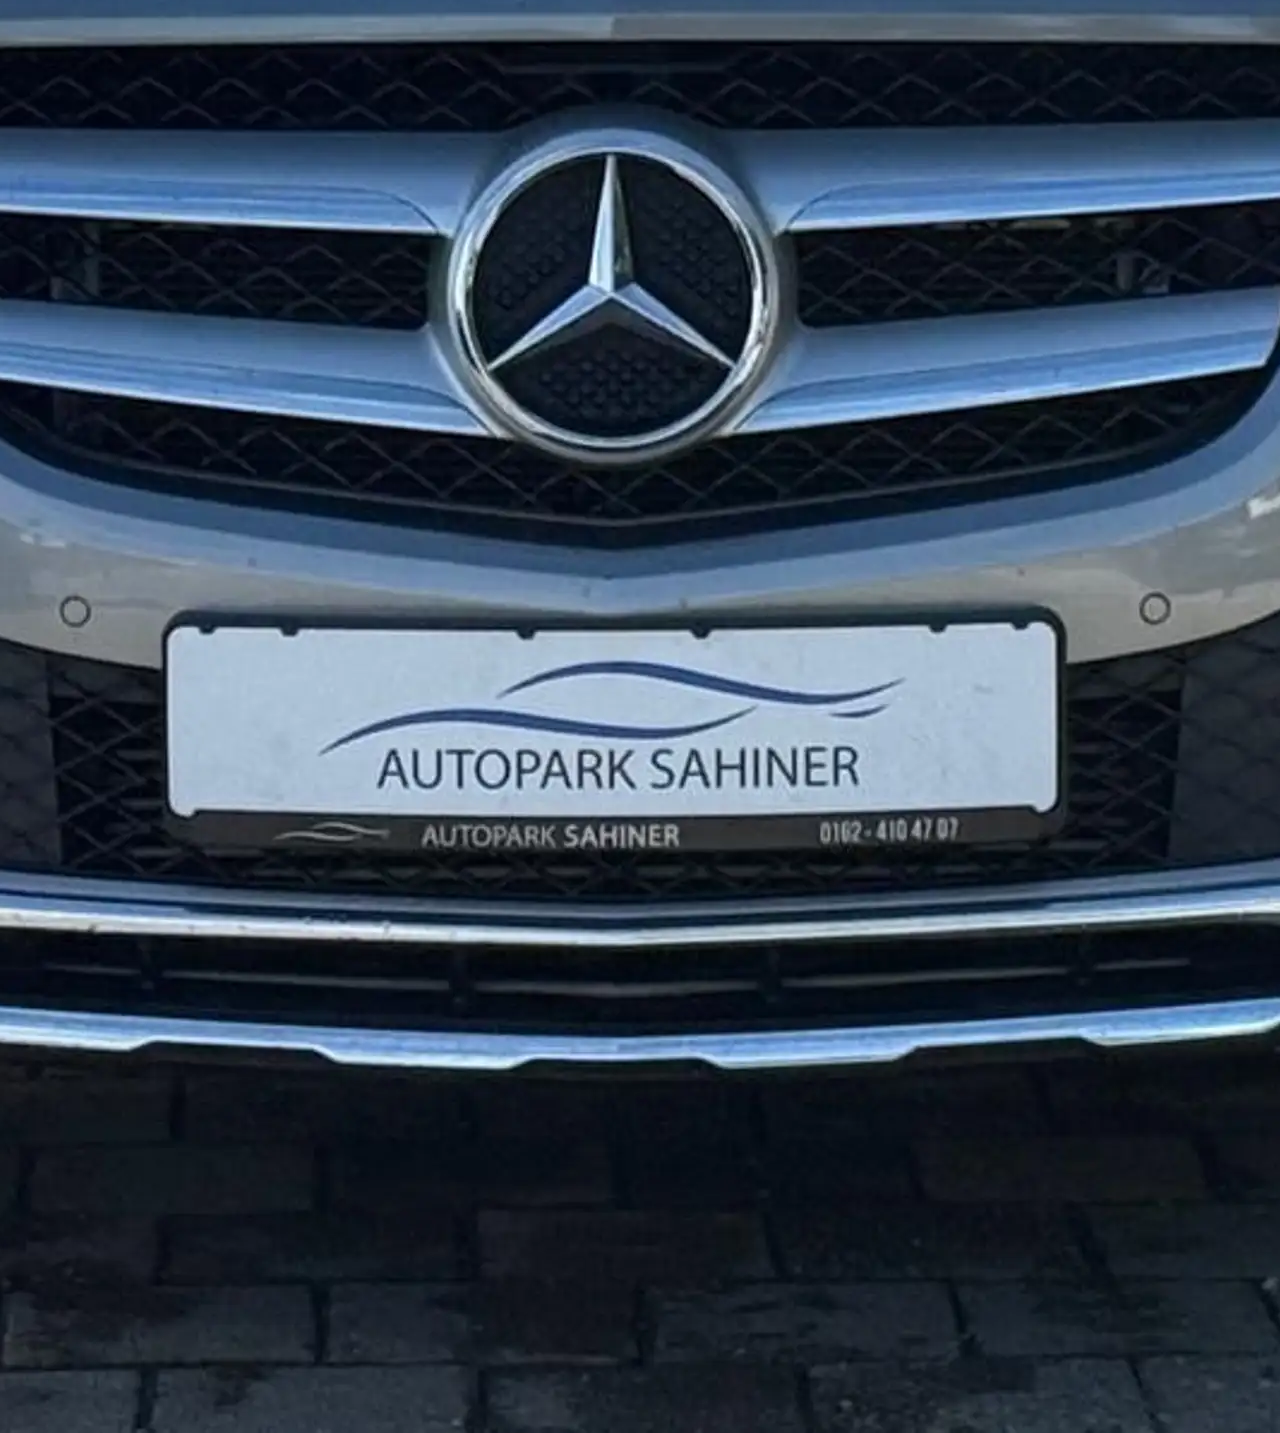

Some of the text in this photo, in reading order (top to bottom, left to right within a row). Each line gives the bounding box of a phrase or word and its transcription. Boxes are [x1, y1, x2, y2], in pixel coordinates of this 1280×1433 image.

[376, 745, 860, 791] AUTOPARK SAHINER
[421, 823, 556, 849] AUTOPARK
[563, 821, 680, 849] SAHINER
